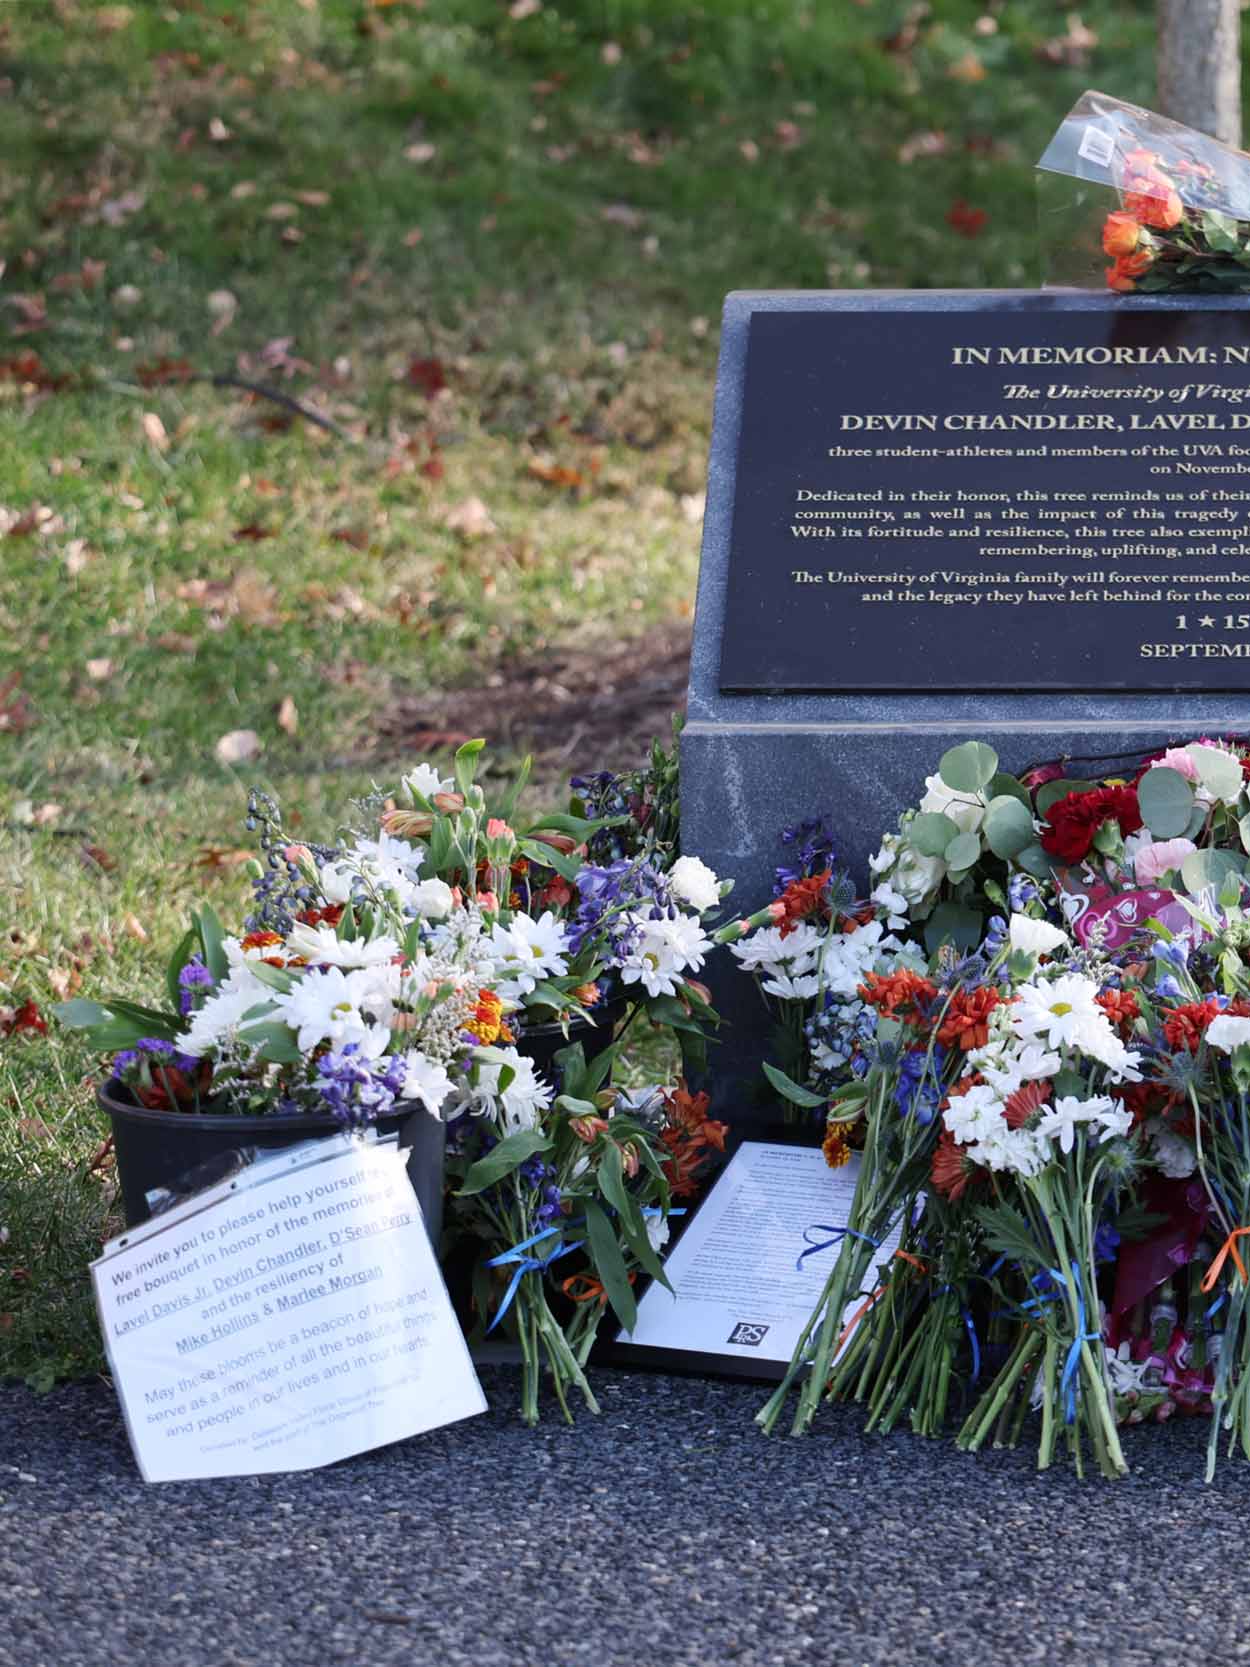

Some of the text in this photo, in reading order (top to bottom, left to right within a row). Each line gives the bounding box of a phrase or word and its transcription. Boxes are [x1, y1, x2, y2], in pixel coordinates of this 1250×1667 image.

[952, 347, 992, 364] IN
[997, 346, 1217, 365] MEMORIAM:
[1003, 384, 1041, 399] The
[1046, 384, 1164, 404] University
[1168, 384, 1196, 403] of
[840, 414, 938, 431] DEVIN
[944, 414, 1124, 432] CHANDLER,
[1129, 414, 1226, 430] LAVEL
[828, 446, 872, 457] three
[876, 445, 1013, 457] student-athletes
[1016, 445, 1048, 456] and
[1051, 445, 1128, 456] members
[1130, 444, 1151, 456] of
[1151, 444, 1180, 456] the
[1183, 444, 1224, 456] UVA
[1150, 466, 1172, 474] on
[796, 489, 883, 501] Dedicated
[888, 490, 905, 501] in
[911, 490, 952, 501] their
[957, 490, 1011, 503] honor,
[1016, 490, 1048, 501] this
[1053, 492, 1087, 501] tree
[1091, 489, 1160, 501] reminds
[1165, 493, 1184, 501] us
[1188, 489, 1209, 501] of
[794, 508, 896, 522] community,
[903, 511, 921, 519] as
[929, 508, 965, 519] well
[974, 511, 992, 520] as
[1001, 508, 1030, 519] the
[1038, 508, 1097, 522] impact
[1106, 507, 1126, 519] of
[1132, 507, 1165, 520] this
[1174, 507, 1239, 522] tragedy
[790, 525, 836, 537] With
[841, 526, 863, 537] its
[867, 525, 944, 537] fortitude
[948, 525, 980, 537] and
[985, 526, 1070, 539] resilience,
[1074, 526, 1107, 537] this
[1112, 528, 1146, 537] tree
[1150, 525, 1184, 537] also
[979, 544, 1098, 559] remembering,
[1101, 543, 1182, 559] uplifting,
[1185, 543, 1217, 555] and
[791, 571, 823, 583] The
[828, 571, 917, 586] University
[919, 571, 941, 586] of
[941, 571, 1010, 586] Virginia
[1014, 571, 1069, 588] family
[1071, 571, 1105, 583] will
[1108, 571, 1170, 583] forever
[861, 589, 894, 601] and
[898, 590, 925, 601] the
[928, 590, 983, 605] legacy
[986, 590, 1024, 605] they
[1027, 590, 1066, 601] have
[1069, 589, 1099, 601] left
[1103, 589, 1162, 601] behind
[1166, 589, 1191, 601] for
[1194, 590, 1222, 601] the
[1176, 614, 1188, 630] 1
[1224, 614, 1250, 629] 15
[112, 1270, 132, 1286] We
[135, 1251, 170, 1275] invite
[173, 1238, 198, 1258] you
[200, 1230, 216, 1242] to
[218, 1208, 265, 1238] please
[268, 1193, 302, 1213] help
[200, 1252, 344, 1320] and the resiliency of
